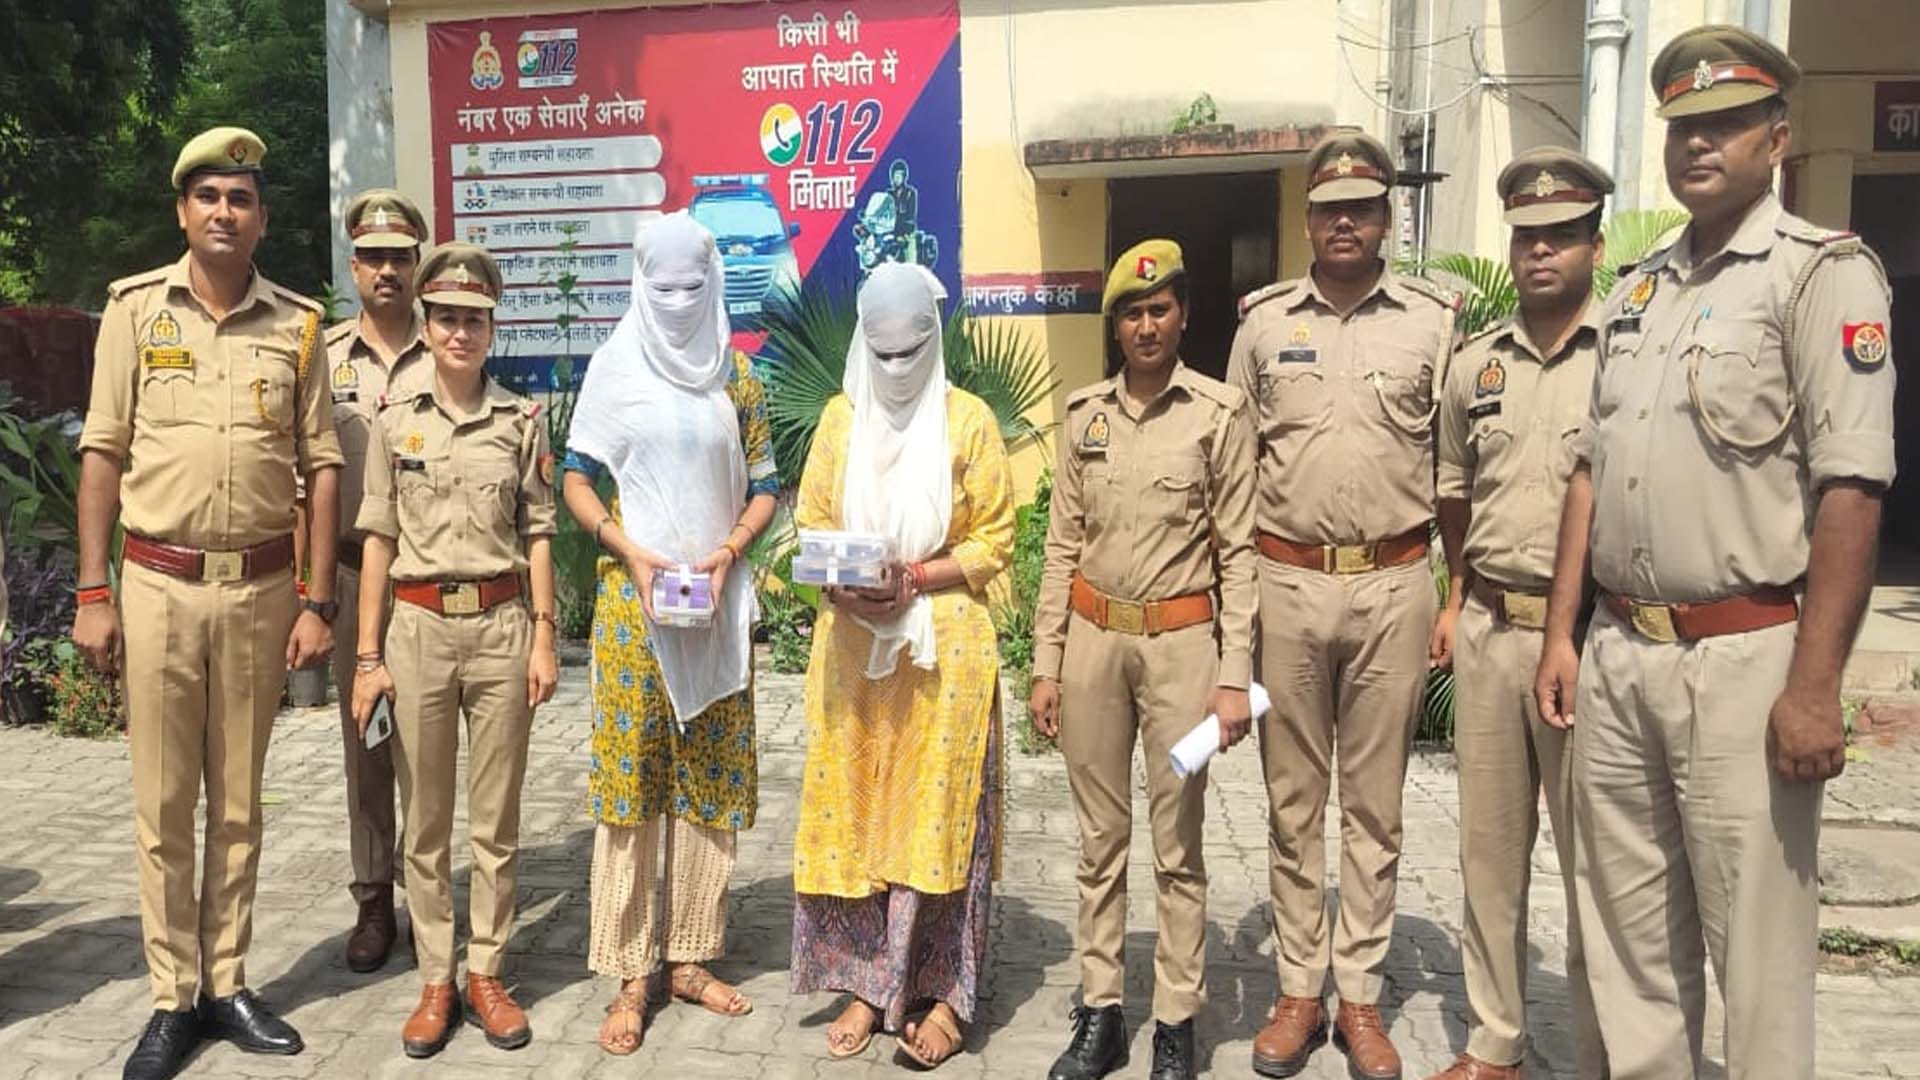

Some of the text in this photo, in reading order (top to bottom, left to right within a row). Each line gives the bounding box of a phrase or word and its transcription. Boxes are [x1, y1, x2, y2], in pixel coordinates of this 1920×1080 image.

[777, 10, 860, 48] किसी भी
[540, 41, 577, 76] 112
[742, 48, 898, 91] आपात स्थिति में
[457, 91, 647, 134] नंबर एक सेवाएँ अनेक
[804, 98, 883, 165] 112
[788, 166, 857, 211] मिलाएं
[1034, 282, 1081, 310] कक्ष
